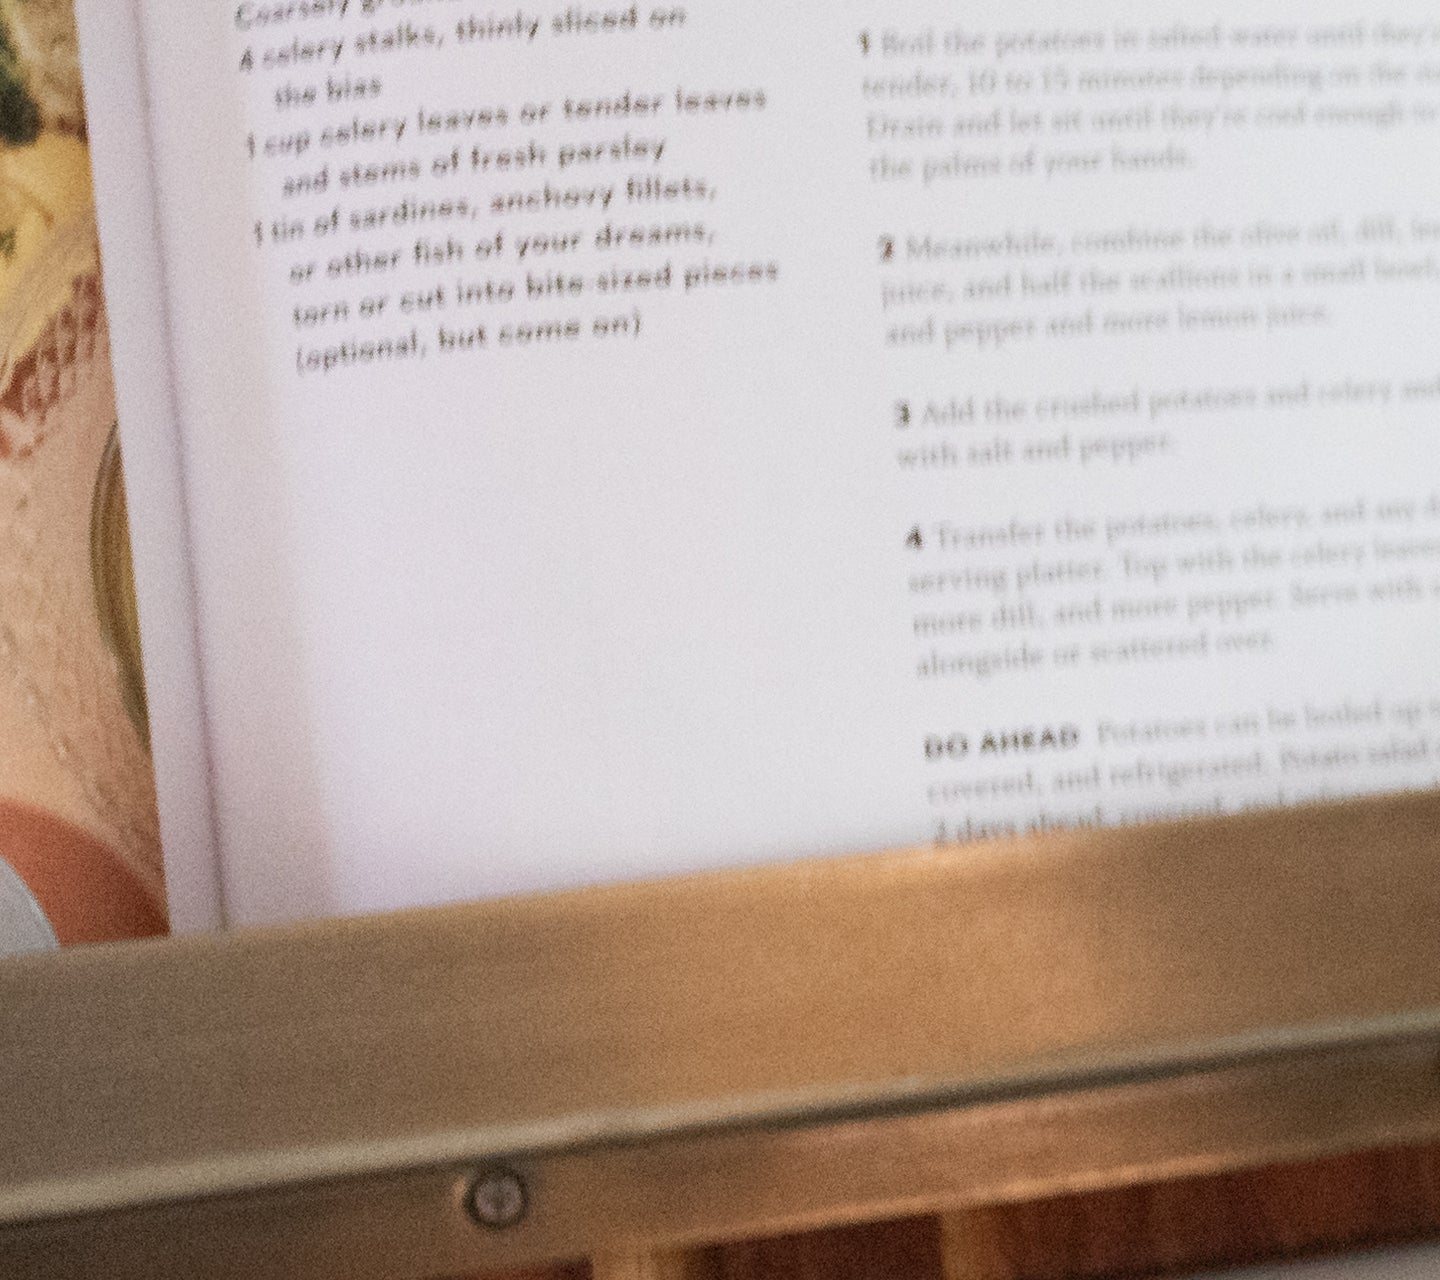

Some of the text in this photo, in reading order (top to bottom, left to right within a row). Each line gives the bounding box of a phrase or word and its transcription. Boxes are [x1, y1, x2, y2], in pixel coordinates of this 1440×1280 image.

[263, 40, 344, 64] celery
[355, 24, 443, 53] stalks,
[456, 13, 539, 42] thinly
[552, 6, 638, 33] sliced
[649, 9, 687, 28] on
[264, 132, 311, 155] cup
[320, 119, 406, 145] celery
[417, 108, 508, 131] leaves
[520, 105, 549, 122] or
[563, 91, 662, 118] tender
[675, 88, 767, 112] leaves
[274, 78, 382, 108] the bias
[283, 135, 665, 197] and stems of fresh parsley
[271, 222, 304, 242] tin
[314, 208, 339, 234] of
[350, 200, 476, 229] sardines,
[491, 185, 613, 212] anchovy
[626, 177, 716, 200] fillets,
[289, 224, 714, 283] or other fish of your dreams,
[293, 303, 349, 327] torn
[359, 298, 386, 316] or
[400, 287, 444, 310] cut
[457, 281, 514, 302] into
[684, 262, 779, 291] pieces
[296, 312, 642, 375] (optional, but come on)
[924, 726, 1080, 760] DO AHEAD
